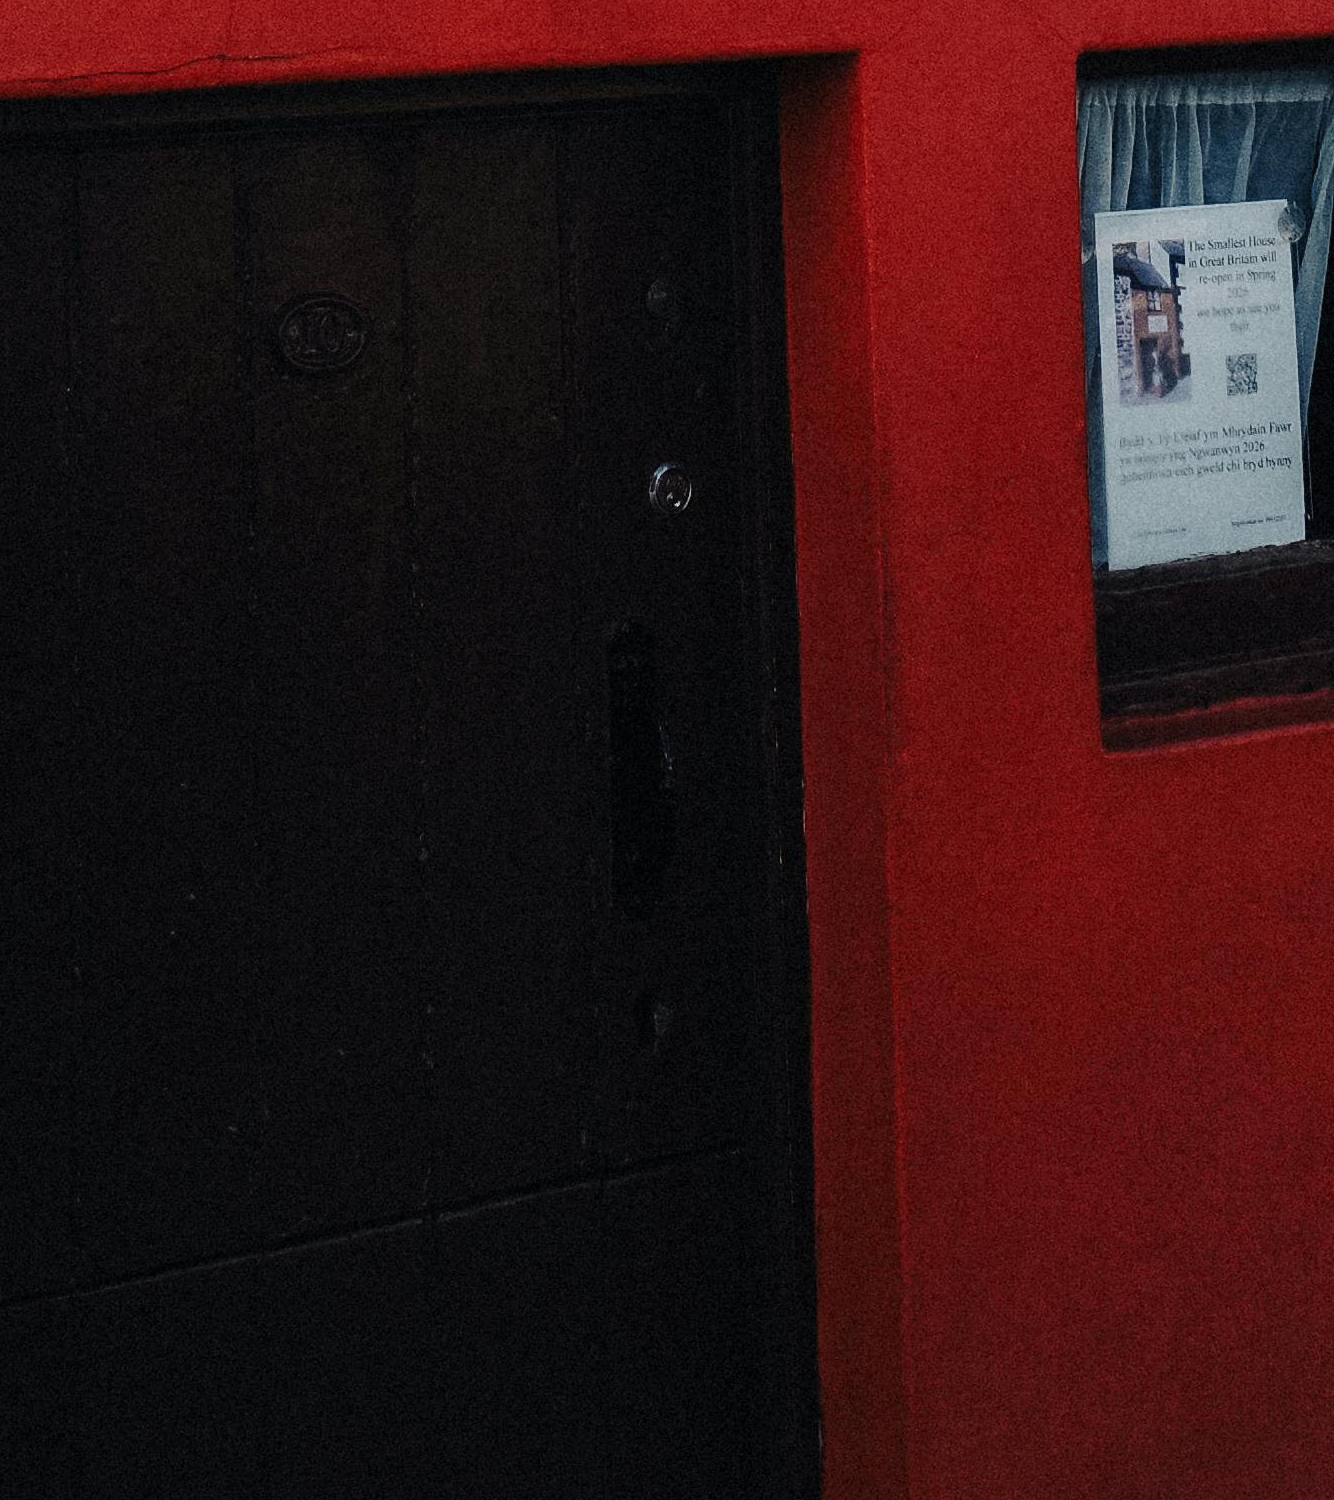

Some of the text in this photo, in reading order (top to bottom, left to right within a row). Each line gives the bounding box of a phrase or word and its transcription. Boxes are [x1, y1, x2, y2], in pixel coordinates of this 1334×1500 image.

[1189, 236, 1276, 252] The Smallest House
[1189, 251, 1277, 268] in Great Britain will
[1222, 423, 1267, 439] Mhrydain
[1243, 440, 1266, 453] 2026
